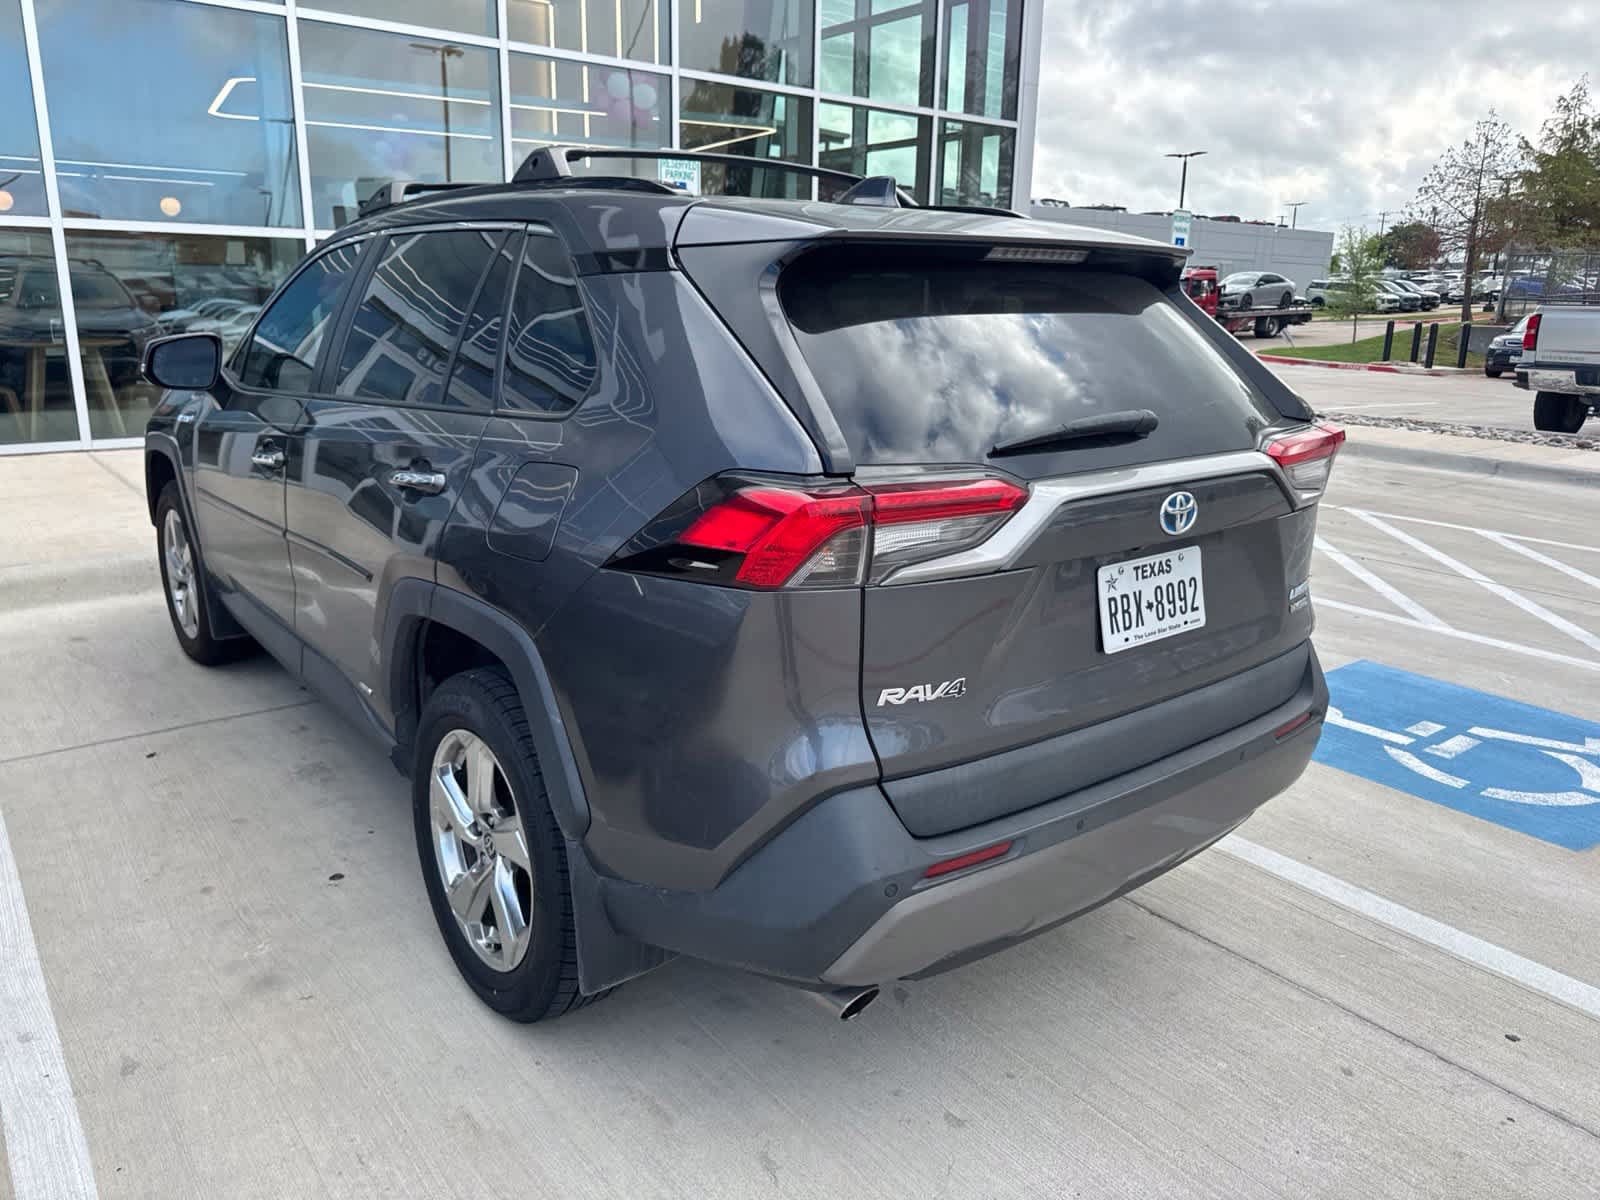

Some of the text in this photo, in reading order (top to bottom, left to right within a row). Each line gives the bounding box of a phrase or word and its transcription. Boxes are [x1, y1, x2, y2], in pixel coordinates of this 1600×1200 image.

[664, 168, 695, 182] PARKING
[1133, 558, 1172, 581] TEXAS
[1133, 623, 1182, 641] The Lone Star State
[876, 677, 966, 706] RAV4
